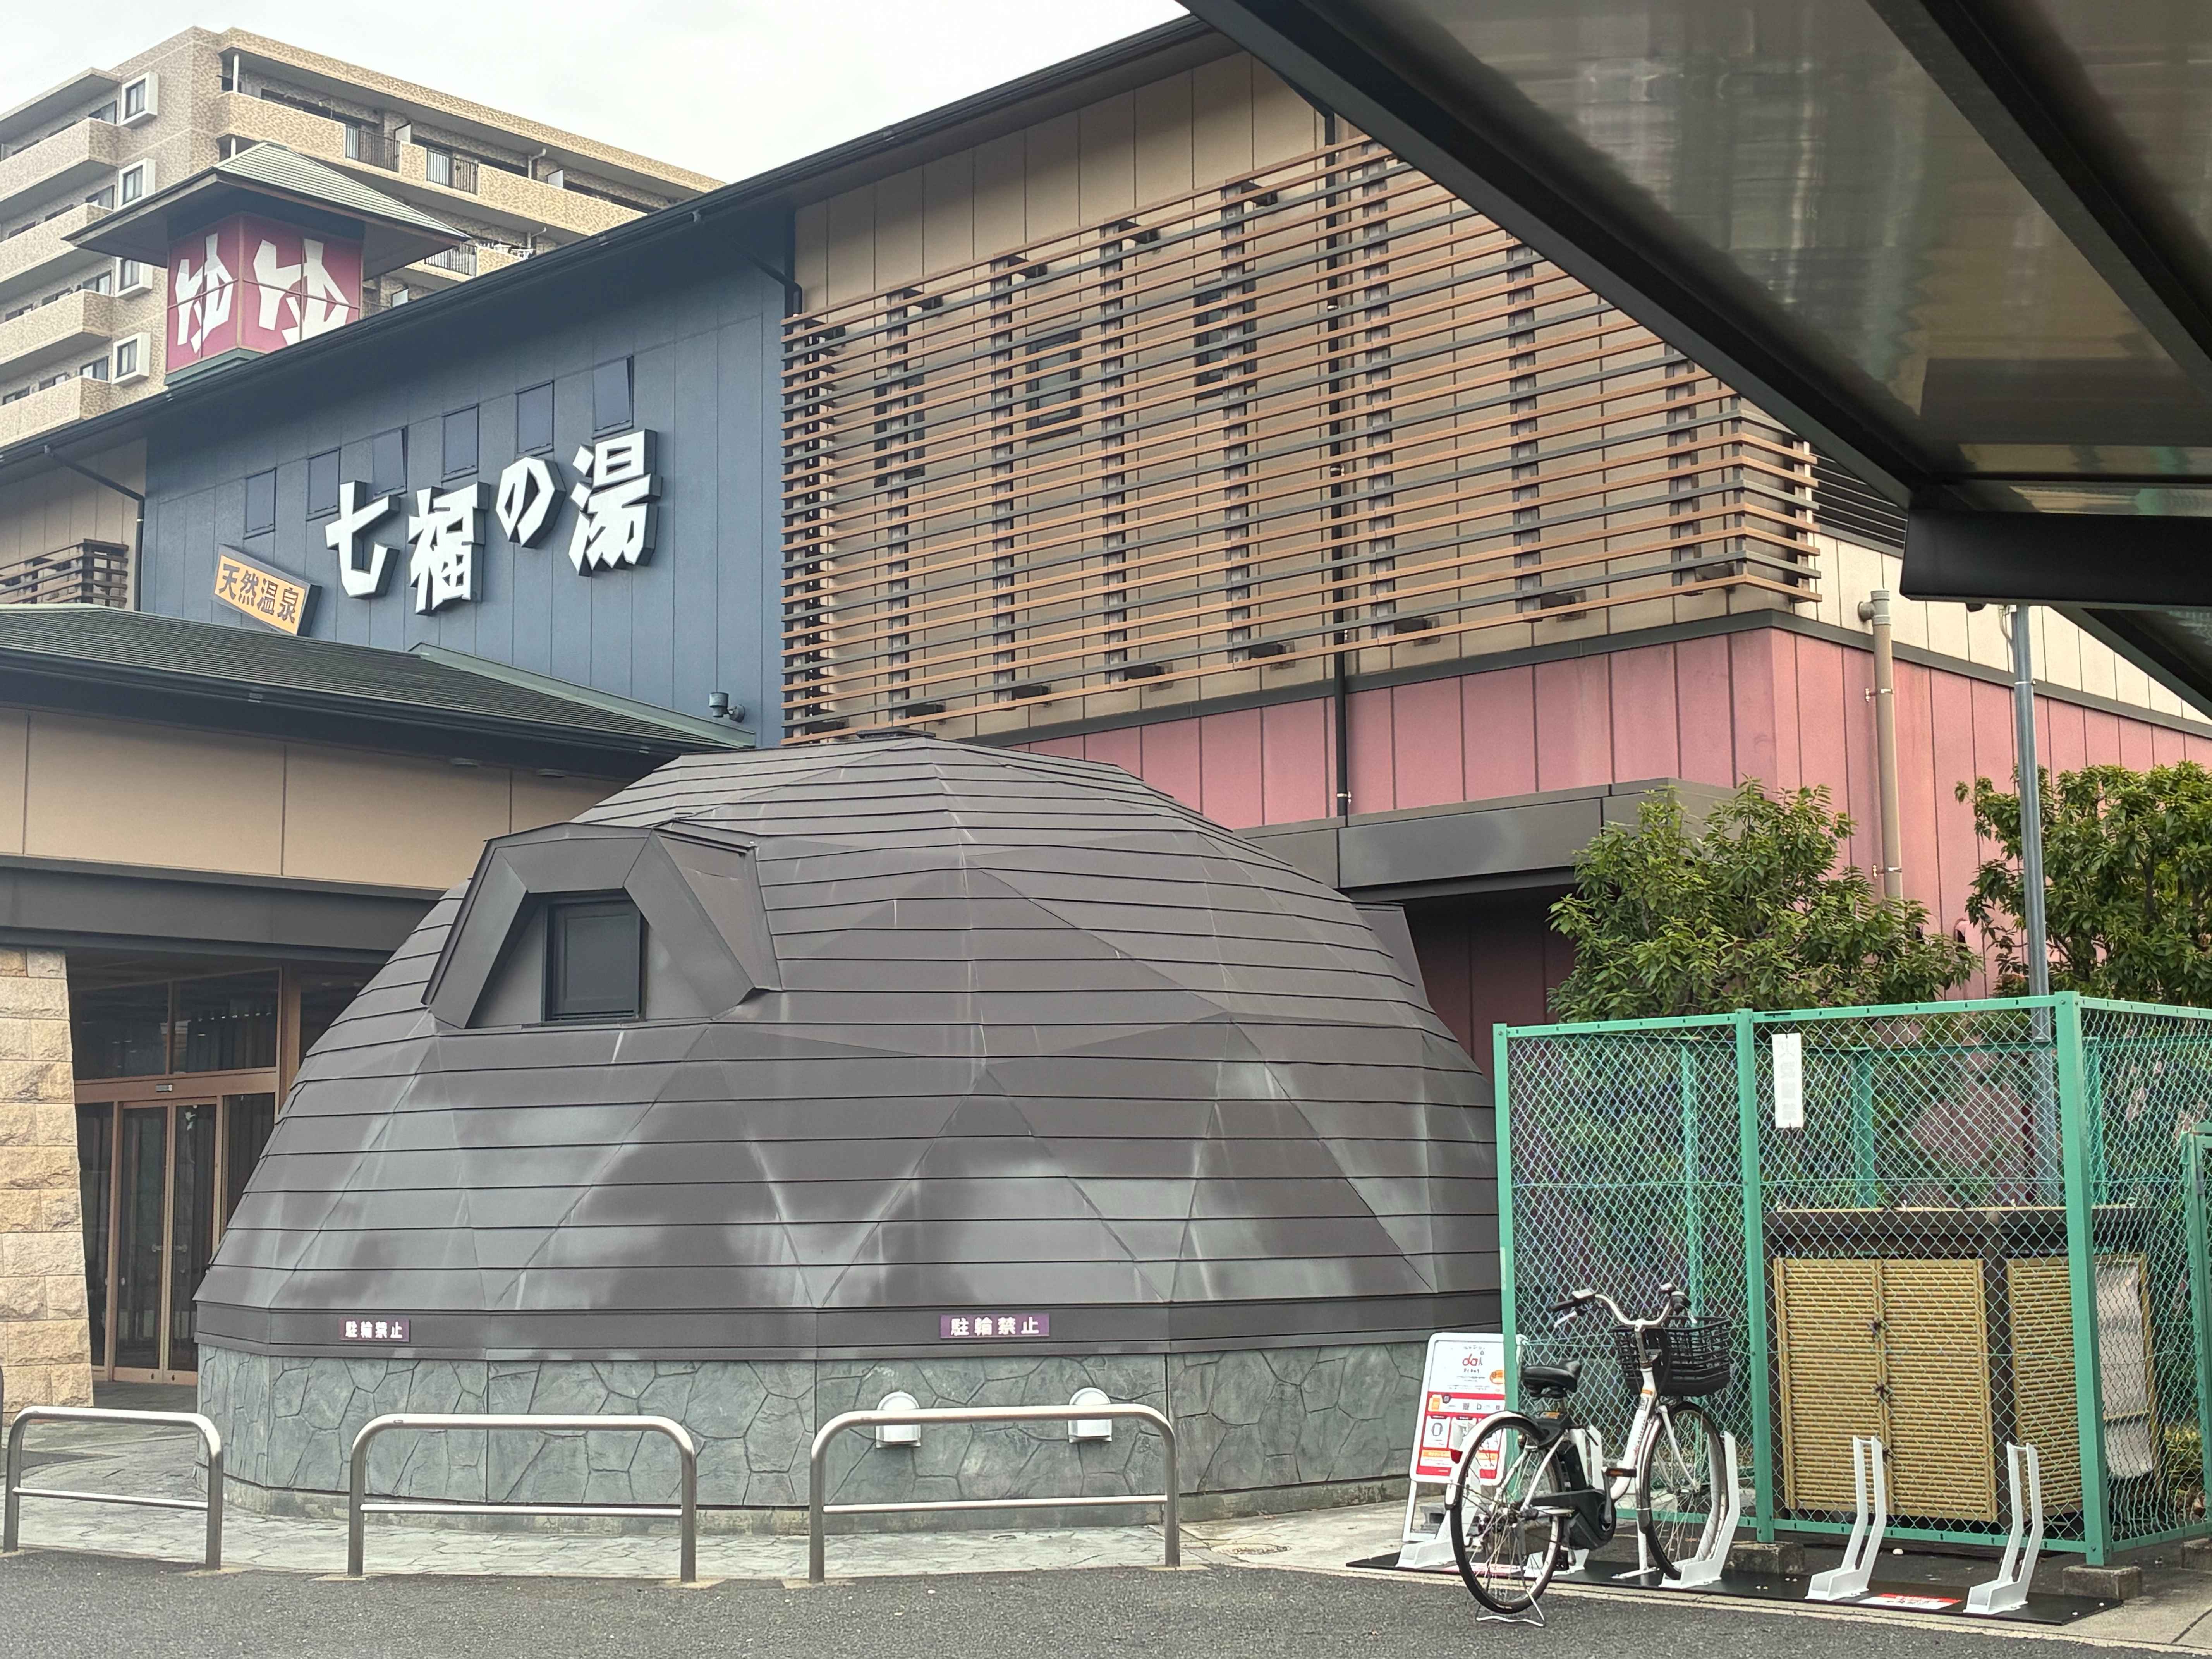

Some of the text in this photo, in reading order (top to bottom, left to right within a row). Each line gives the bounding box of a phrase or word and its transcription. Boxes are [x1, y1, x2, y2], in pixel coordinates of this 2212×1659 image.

[175, 233, 234, 354] ゆ
[325, 429, 656, 615] 七福の湯
[219, 563, 299, 624] 天然温泉
[345, 1321, 403, 1339] 駐輪禁止
[950, 1317, 1039, 1336] 駐輪禁止
